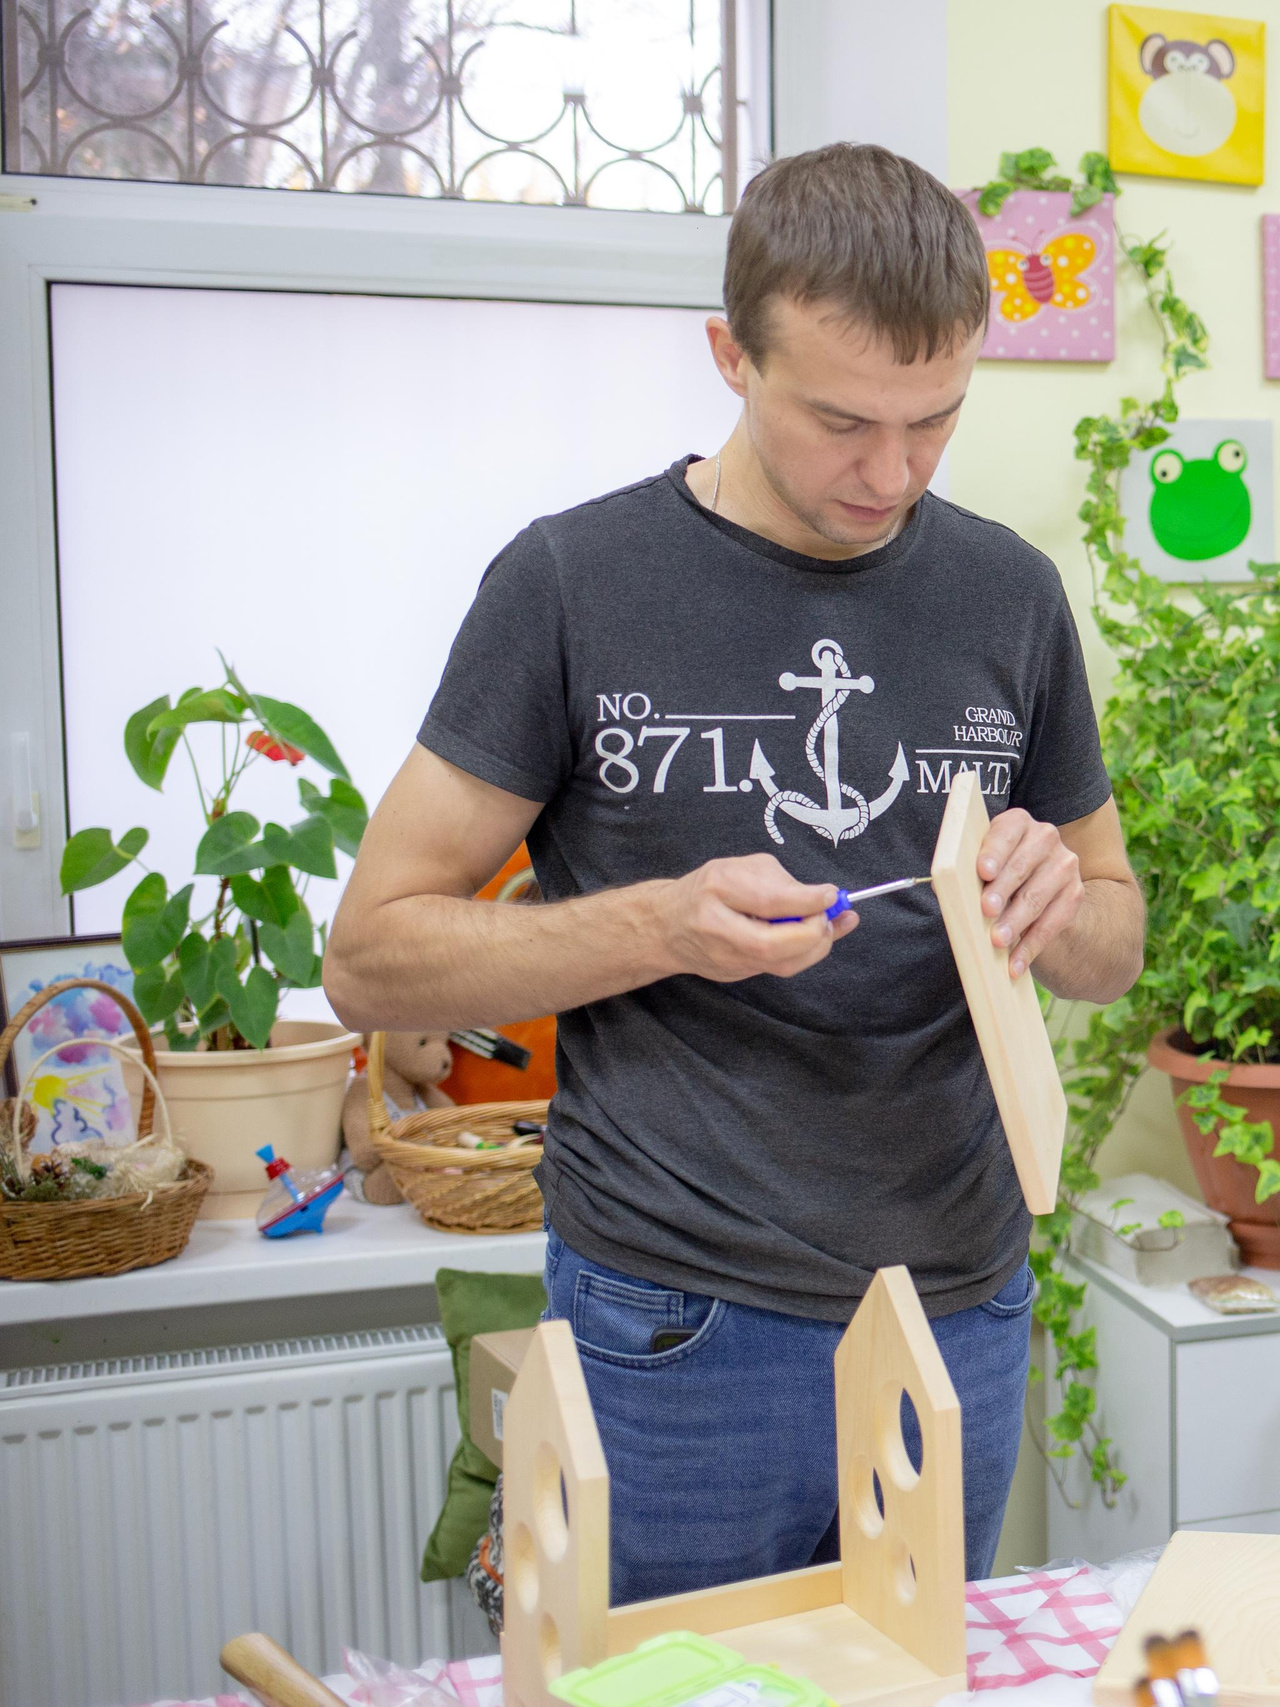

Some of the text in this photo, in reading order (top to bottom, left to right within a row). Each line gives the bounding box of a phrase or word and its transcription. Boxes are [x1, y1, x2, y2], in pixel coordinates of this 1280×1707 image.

[596, 692, 660, 721] NO.
[965, 706, 1016, 727] GRAND
[952, 725, 1023, 747] HARBOUR
[594, 725, 754, 794] 871.
